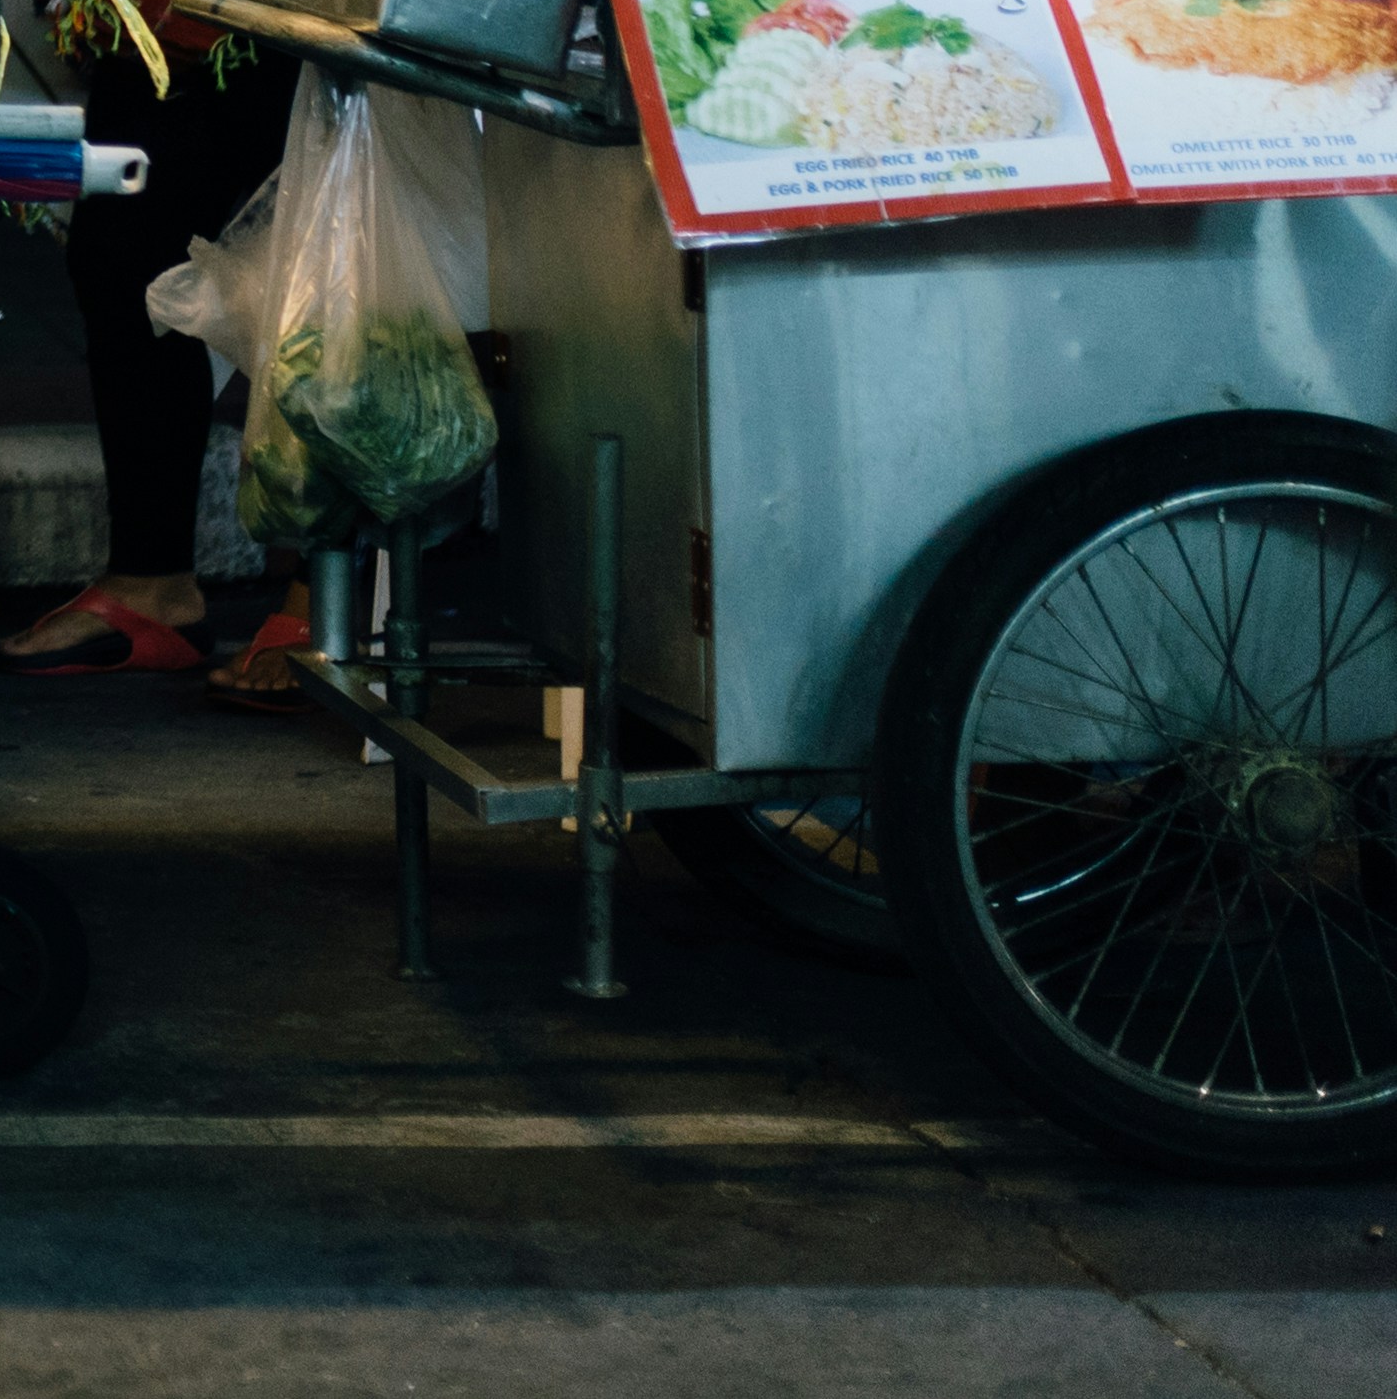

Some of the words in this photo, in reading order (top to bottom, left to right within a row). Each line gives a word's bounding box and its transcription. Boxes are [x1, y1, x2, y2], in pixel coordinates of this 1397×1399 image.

[1171, 139, 1254, 154] OMELETTE
[1260, 137, 1294, 150] RICE
[1303, 136, 1321, 148] 30
[1325, 134, 1357, 147] THB
[795, 160, 828, 174] EGG
[833, 156, 877, 171] FRIED
[881, 153, 915, 166] RICE
[924, 151, 943, 164] 40
[949, 148, 980, 161] THB
[1131, 161, 1213, 176] OMELETTE
[1217, 158, 1259, 172] WITH
[1266, 156, 1309, 170] PORK
[1314, 154, 1347, 167] RICE
[1356, 154, 1375, 166] 40
[1381, 153, 1397, 164] TH
[769, 183, 802, 196] EGG
[806, 181, 820, 194] &
[823, 178, 867, 193] PORK
[873, 174, 916, 189] FRIED
[921, 171, 955, 184] RICE
[963, 169, 982, 181] 50
[988, 166, 1018, 179] THB
